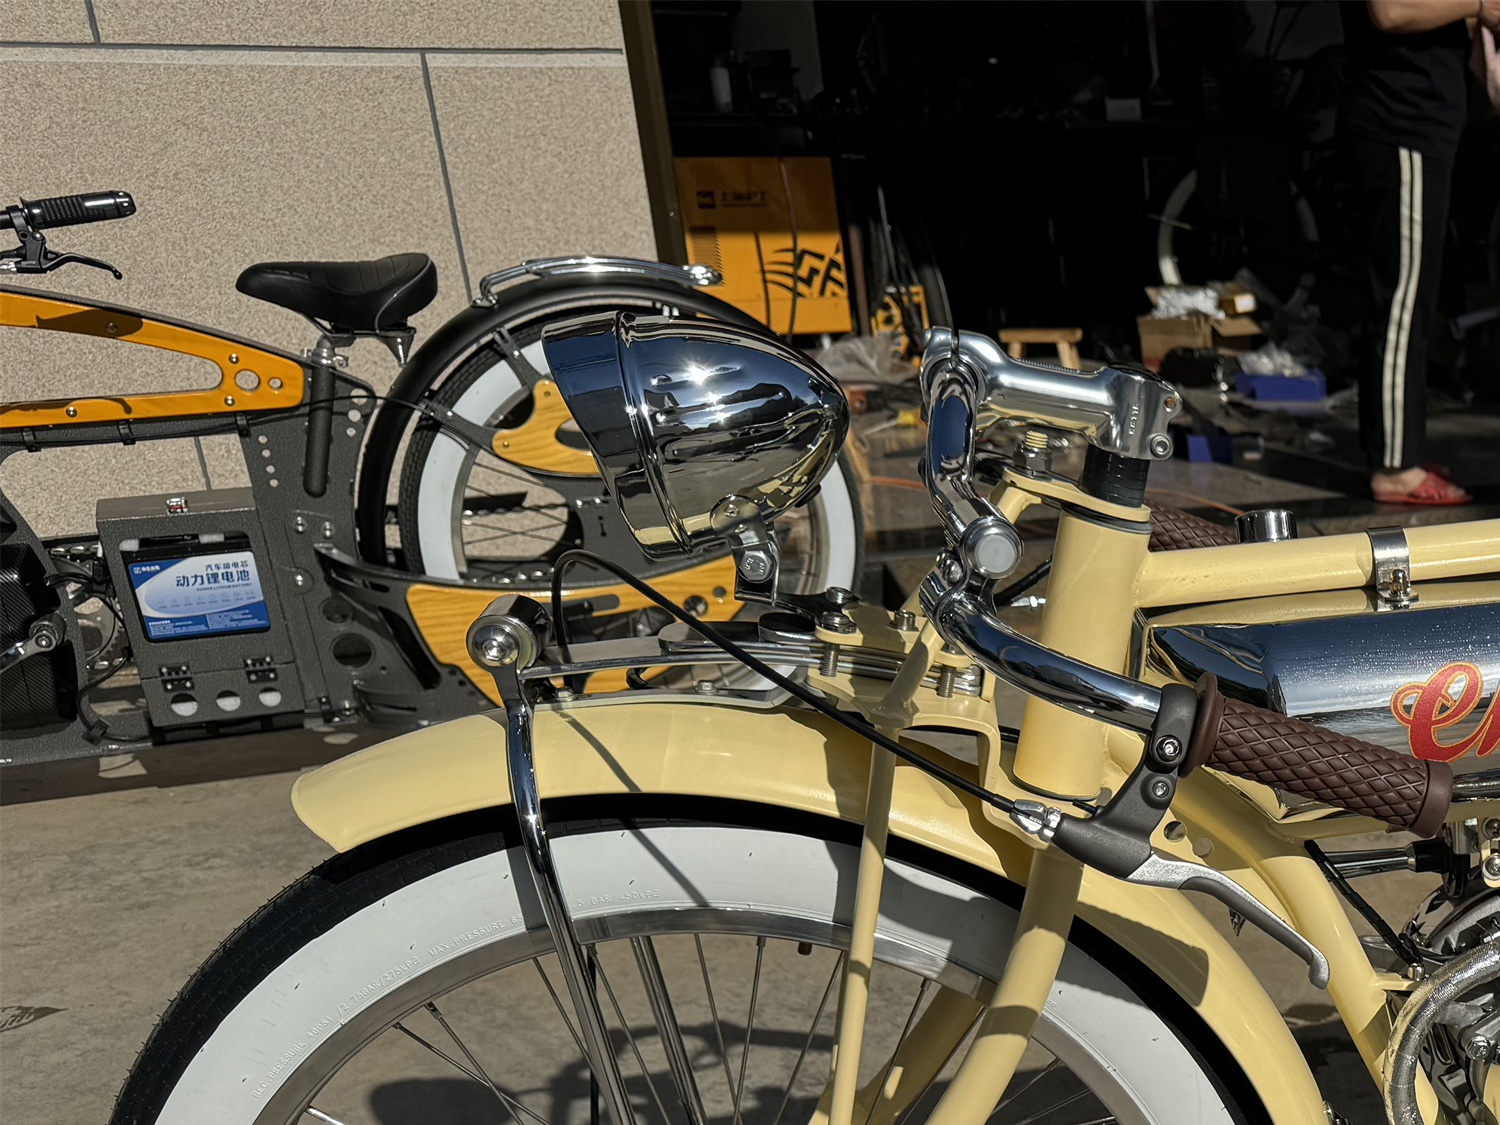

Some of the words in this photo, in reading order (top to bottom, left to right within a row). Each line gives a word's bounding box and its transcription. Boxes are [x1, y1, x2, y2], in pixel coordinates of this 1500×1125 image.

[205, 560, 248, 571] 汽车级电芯
[175, 570, 250, 587] 动力锂电池
